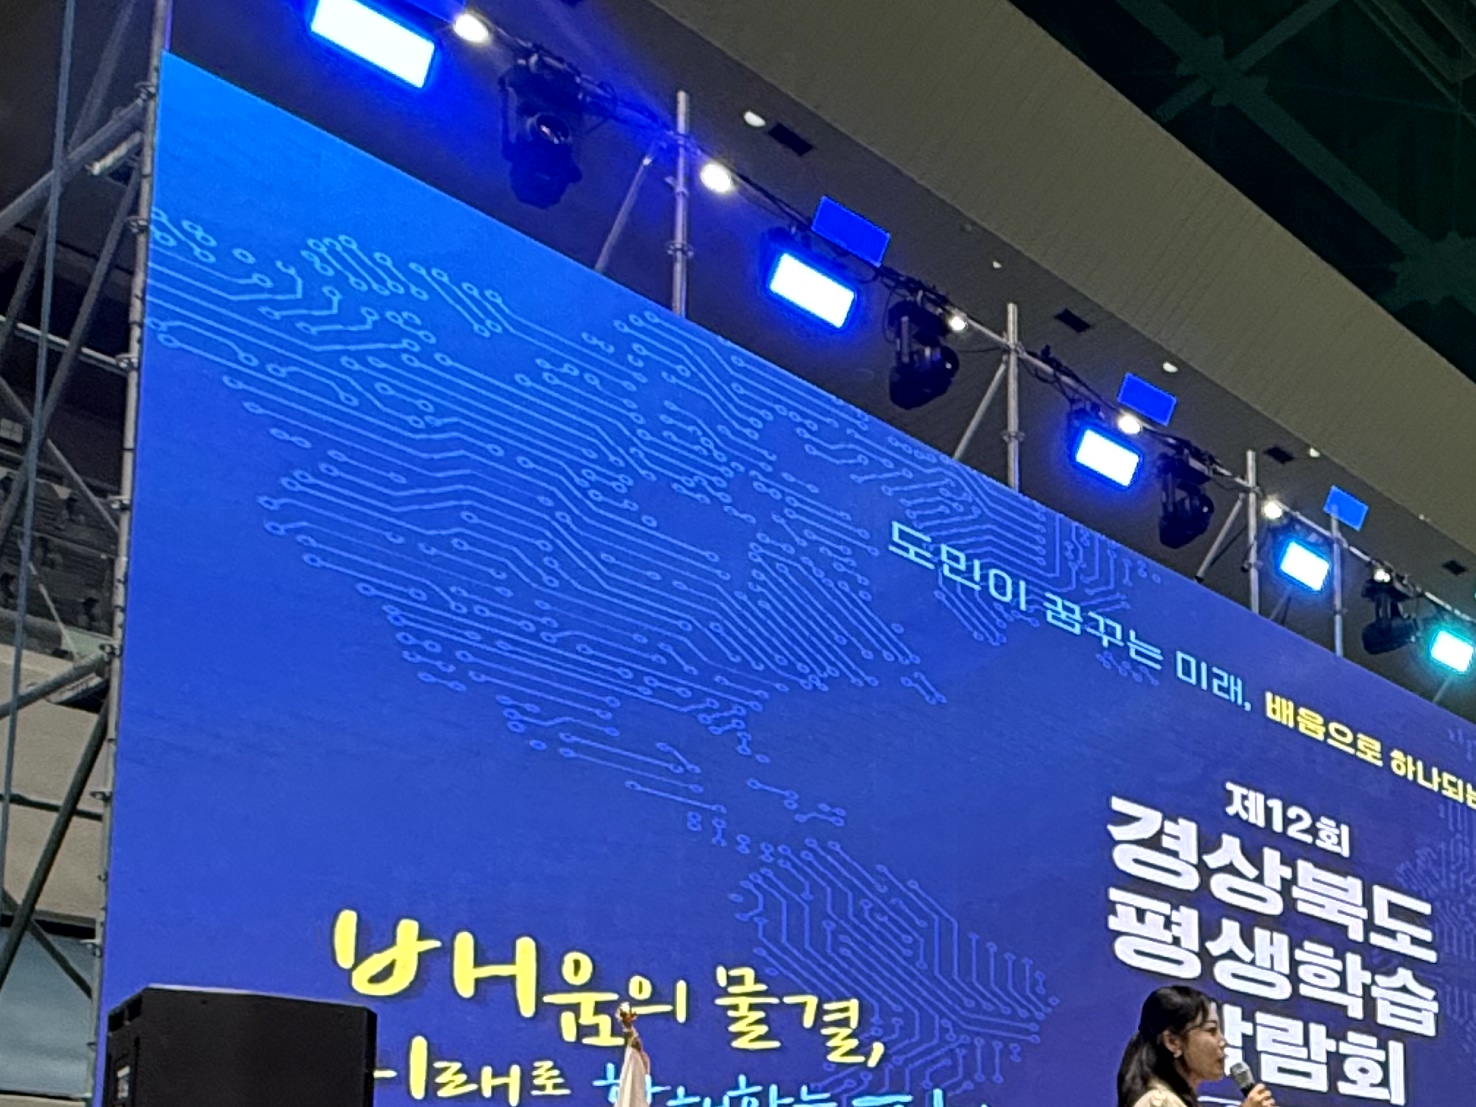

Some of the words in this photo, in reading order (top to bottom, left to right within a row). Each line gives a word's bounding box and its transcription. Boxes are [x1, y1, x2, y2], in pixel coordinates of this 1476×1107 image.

[889, 520, 1027, 612] 도민이
[1044, 591, 1164, 671] 꿈꾸는
[1176, 650, 1252, 712] 미래,
[1107, 796, 1438, 964] 경상북도
[1225, 781, 1351, 858] 제12회
[333, 908, 688, 1047] 배움의
[715, 964, 885, 1068] 물결,
[1107, 887, 1439, 1038] 평생학습
